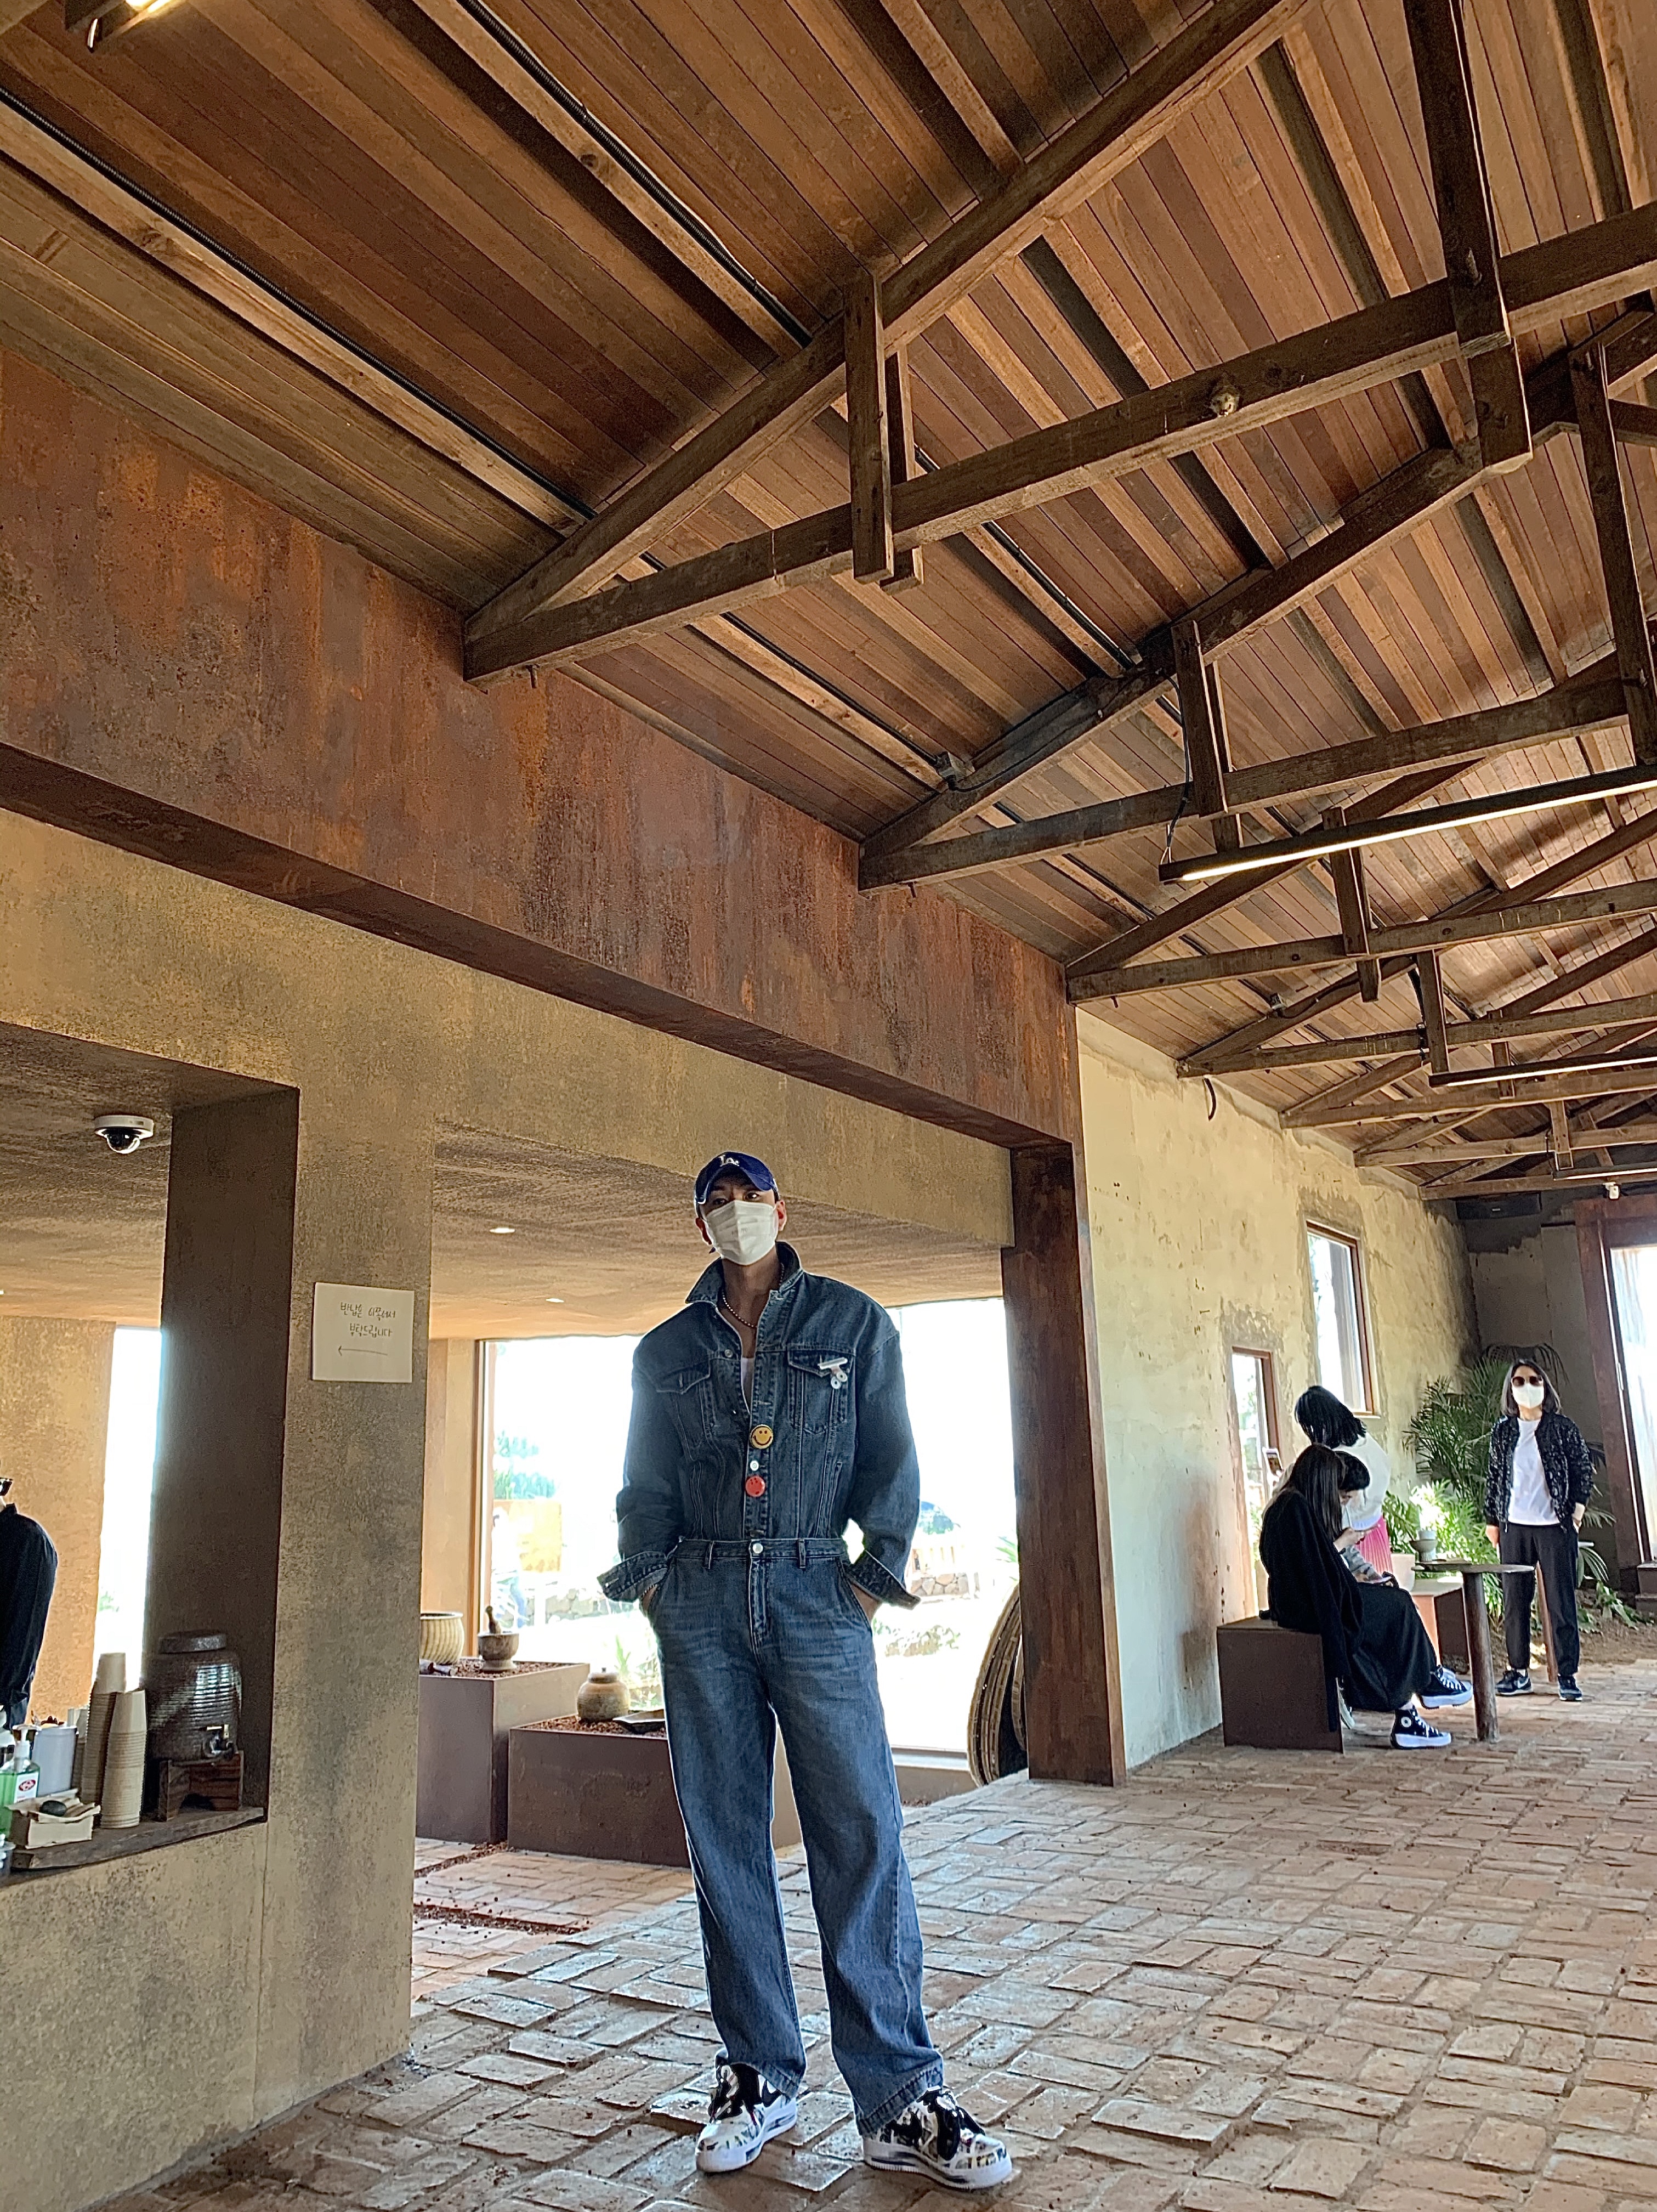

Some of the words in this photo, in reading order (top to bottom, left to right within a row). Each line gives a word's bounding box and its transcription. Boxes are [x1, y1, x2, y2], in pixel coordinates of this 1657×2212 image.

[341, 1302, 362, 1318] 반납은
[368, 1307, 396, 1321] 이쪽에서
[349, 1322, 393, 1338] 부탁드립니다
